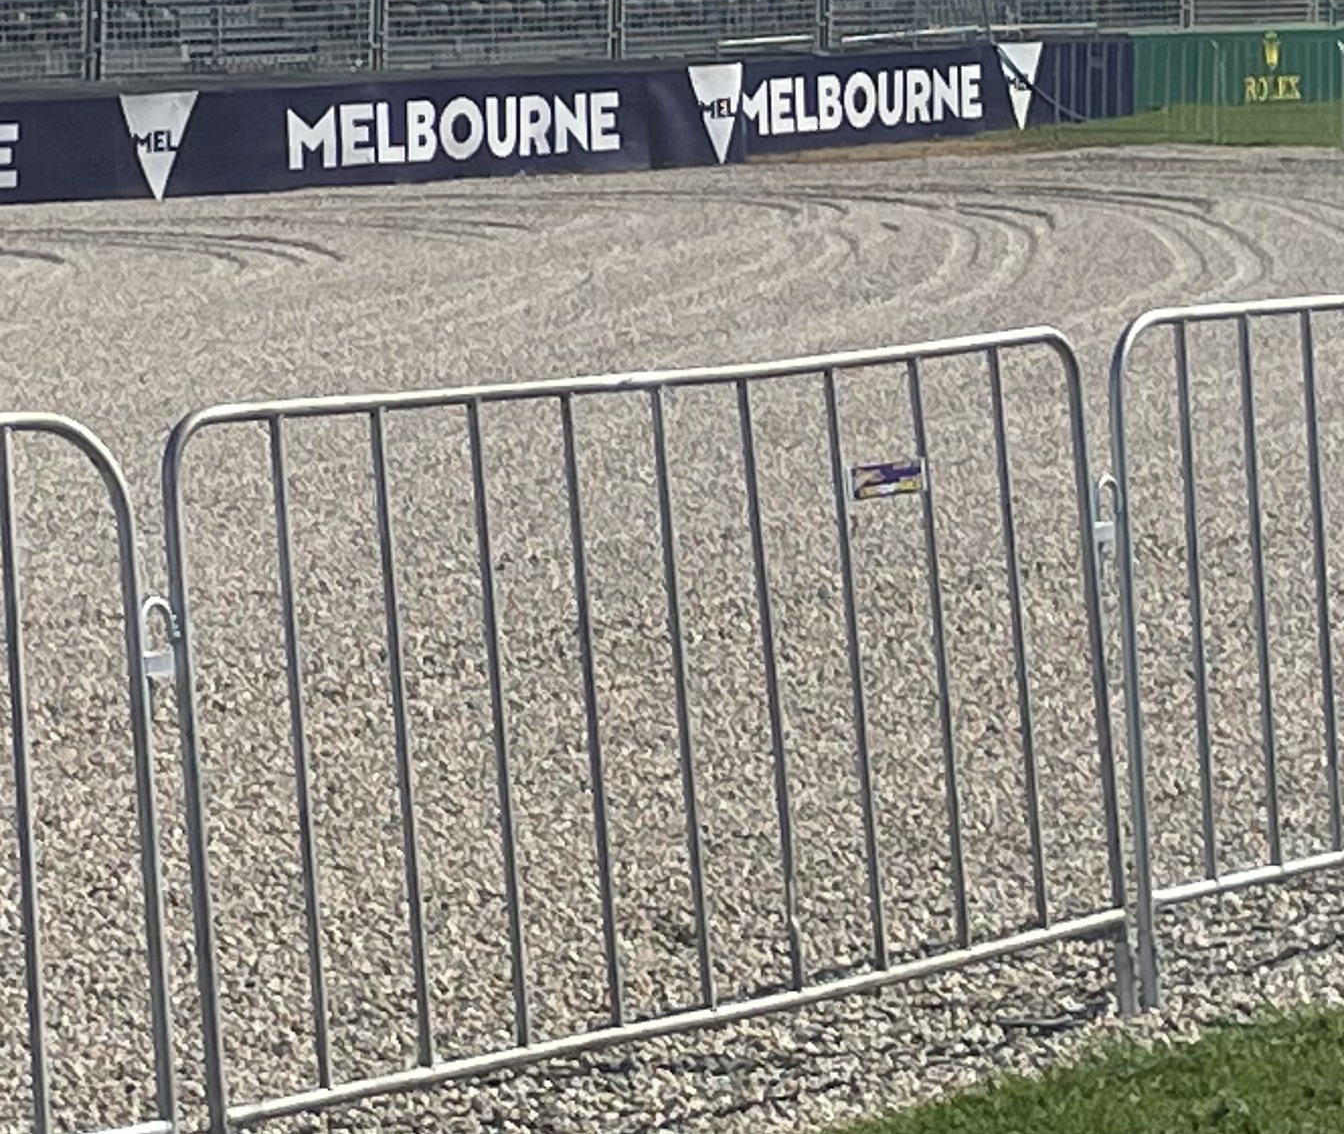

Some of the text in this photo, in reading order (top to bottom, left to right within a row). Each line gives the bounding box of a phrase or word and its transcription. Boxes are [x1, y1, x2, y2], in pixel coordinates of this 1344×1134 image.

[287, 91, 621, 171] MELBOURNE
[742, 63, 983, 136] MELBOURNE
[134, 130, 179, 153] MEL
